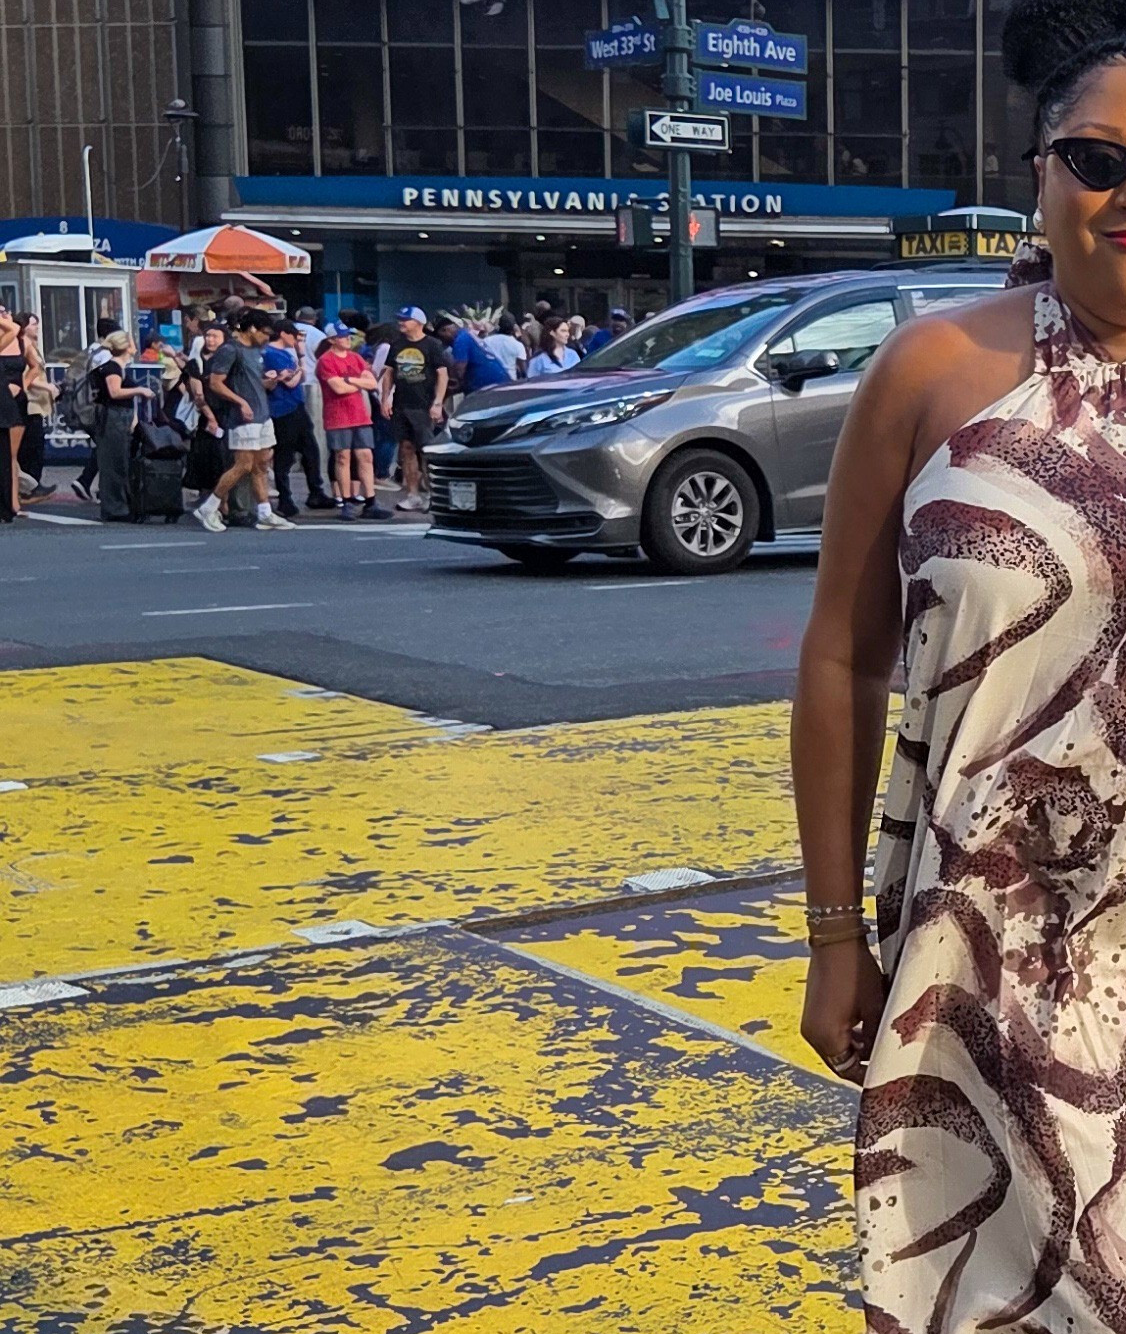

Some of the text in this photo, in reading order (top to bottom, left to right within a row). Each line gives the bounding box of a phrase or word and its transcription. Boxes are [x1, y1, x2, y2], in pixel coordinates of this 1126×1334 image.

[590, 33, 656, 60] West 33rd St
[707, 32, 797, 62] Eighth Ave
[708, 82, 733, 102] Joe
[735, 85, 772, 106] Louis
[661, 122, 716, 138] ONE WAY
[656, 192, 783, 214] STION
[905, 233, 946, 255] TAXI
